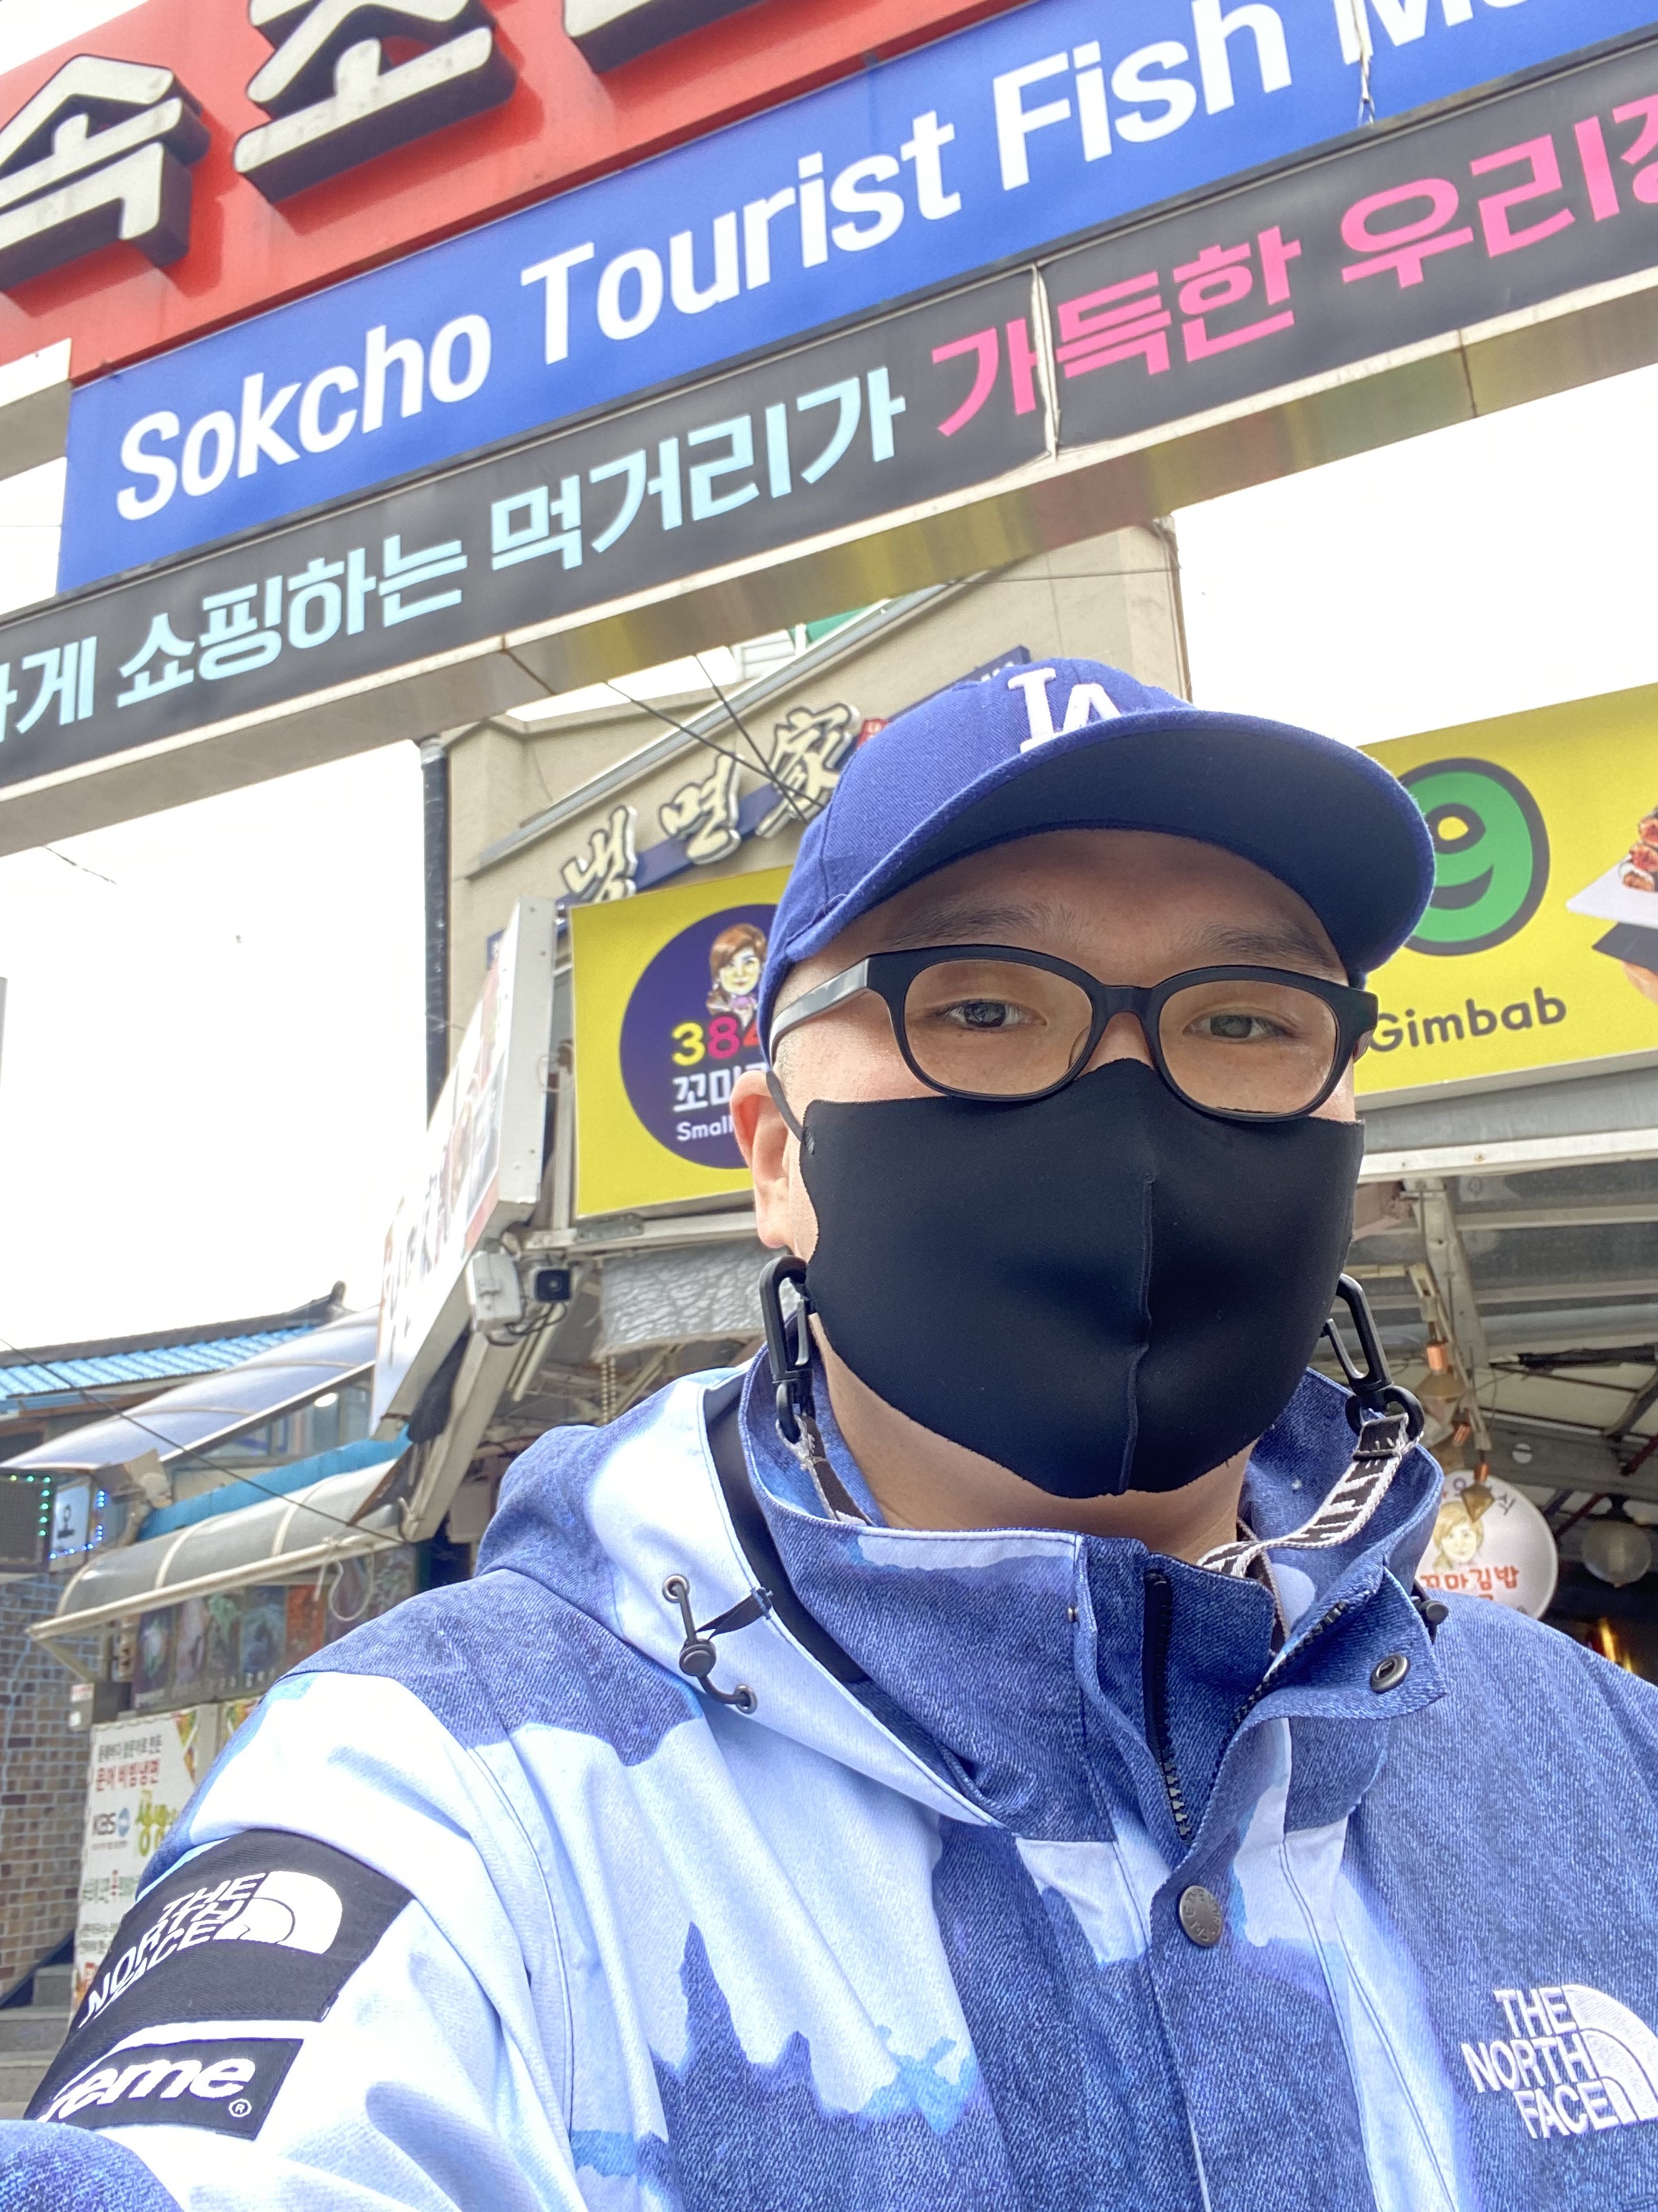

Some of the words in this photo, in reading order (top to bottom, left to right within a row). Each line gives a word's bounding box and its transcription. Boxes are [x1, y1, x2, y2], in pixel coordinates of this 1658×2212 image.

[0, 0, 655, 247] 속초
[115, 314, 492, 521] Sokcho
[520, 111, 962, 365] Tourist
[993, 0, 1291, 191] Fish
[0, 636, 97, 744] 게
[117, 534, 468, 708] 쇼핑하는
[491, 366, 906, 571] 먹거리가
[931, 226, 1301, 436] 가득한
[1008, 668, 1122, 754] LA
[1369, 986, 1566, 1052] Gimbab
[676, 1115, 733, 1141] Small
[1420, 1564, 1519, 1591] 꼬마김밥
[158, 1872, 266, 1923] THE
[78, 1900, 248, 2029] NORTH
[1493, 1986, 1577, 2039] THE
[1461, 2033, 1598, 2093] NORTH
[1513, 2080, 1621, 2139] FACE
